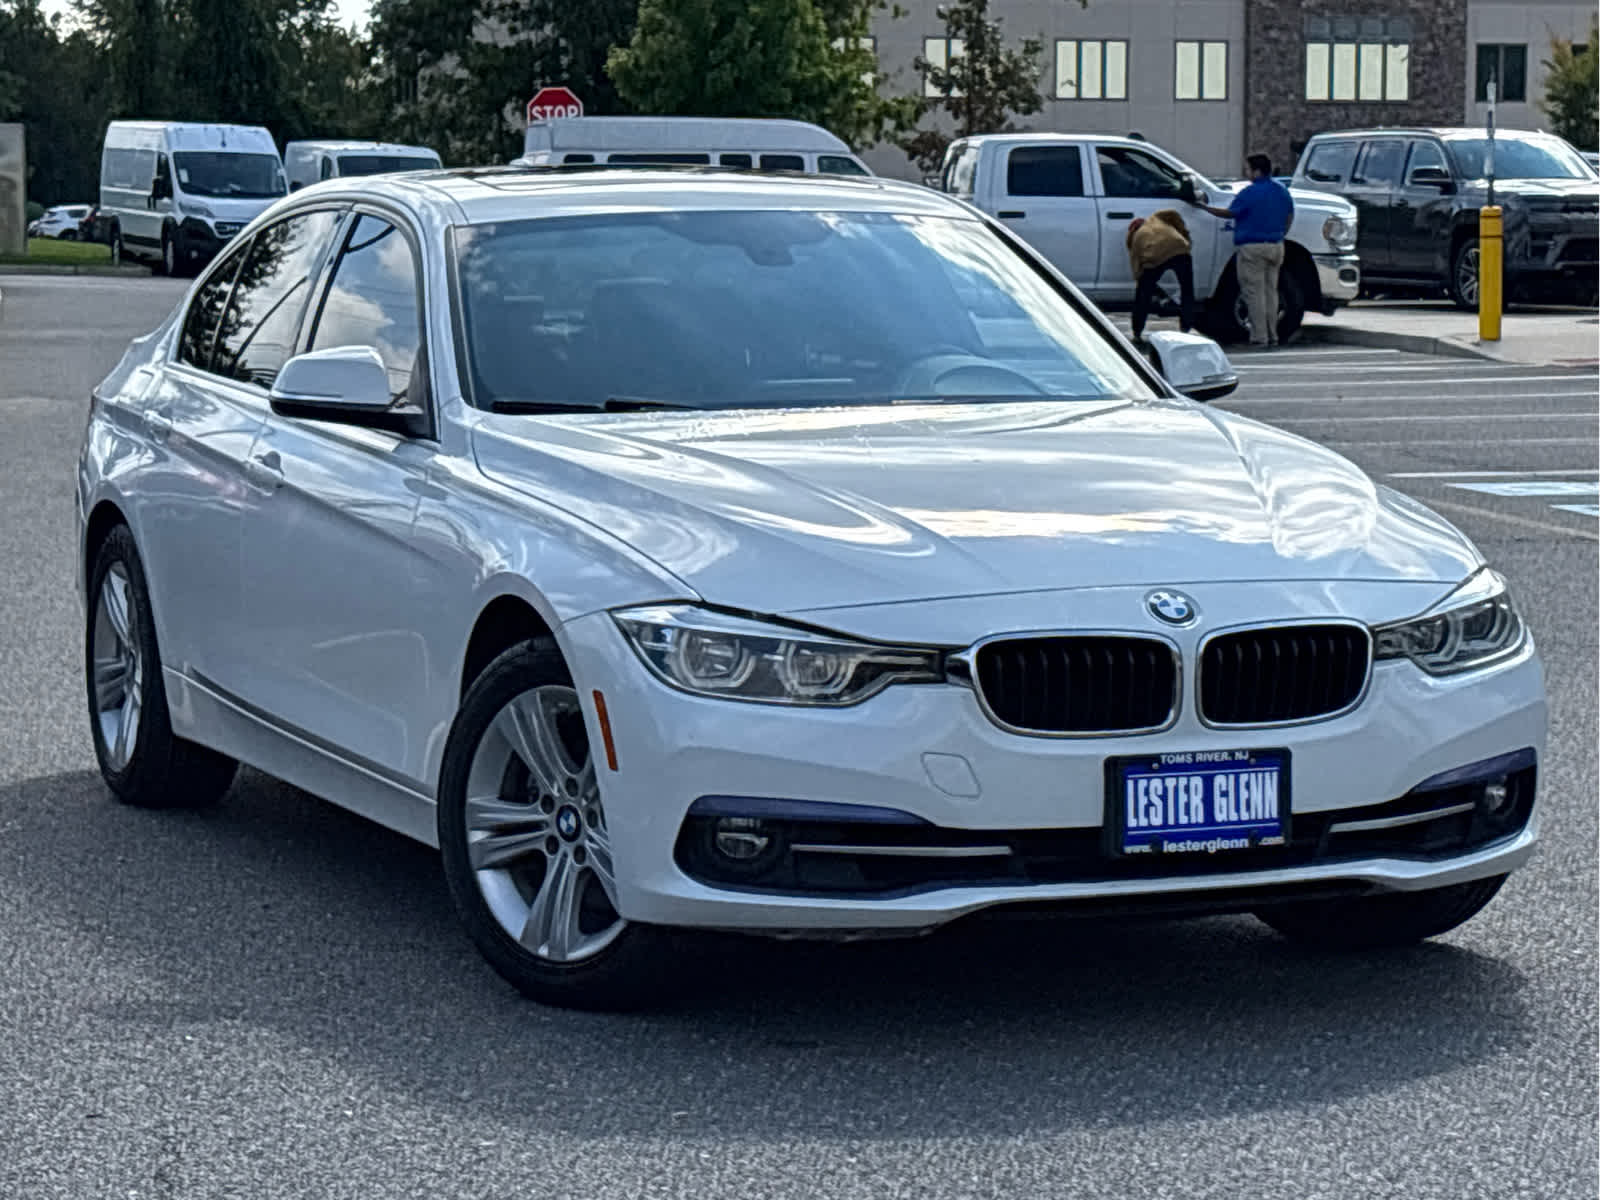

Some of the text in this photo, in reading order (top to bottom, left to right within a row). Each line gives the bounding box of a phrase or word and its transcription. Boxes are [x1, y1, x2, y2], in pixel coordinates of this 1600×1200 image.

[531, 105, 578, 123] STOP
[1160, 753, 1193, 765] TOMS
[1234, 749, 1249, 761] NJ
[1127, 771, 1278, 827] LESTER GLENN
[1163, 837, 1248, 853] lesterglenn
